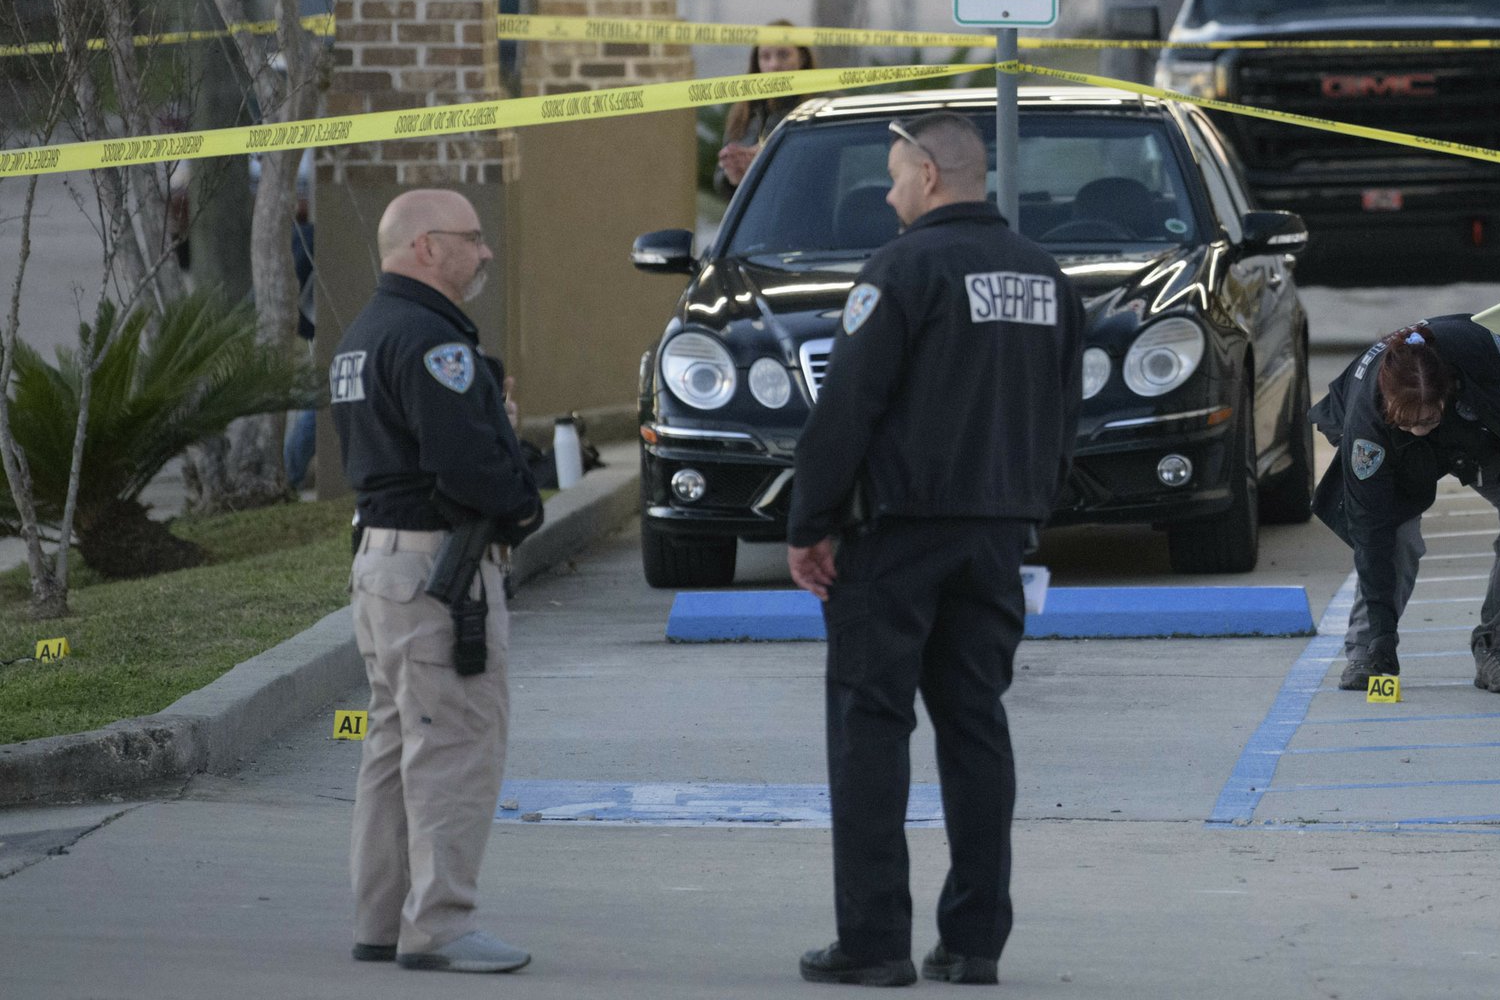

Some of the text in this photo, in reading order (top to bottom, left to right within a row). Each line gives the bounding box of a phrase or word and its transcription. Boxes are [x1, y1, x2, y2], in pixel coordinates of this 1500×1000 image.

[689, 83, 712, 101] CROSS
[713, 81, 728, 99] NOT
[728, 80, 739, 97] DO
[740, 78, 757, 97] LINE
[541, 99, 565, 118] CROSS
[566, 97, 580, 116] NOT
[580, 96, 591, 114] DO
[592, 94, 608, 113] LINE
[394, 114, 420, 133] CROSS
[418, 112, 436, 131] NOT
[434, 111, 447, 130] DO
[445, 110, 463, 128] LINE
[246, 129, 272, 148] CROSS
[270, 127, 288, 146] NOT
[287, 126, 299, 144] DO
[297, 124, 316, 143] LINE
[101, 142, 125, 162] CROSS
[124, 141, 140, 160] NOT
[139, 140, 151, 159] DO
[150, 138, 168, 157] LINE
[970, 277, 1053, 321] SHERIFF
[1369, 678, 1395, 697] AG
[339, 715, 362, 735] AI
